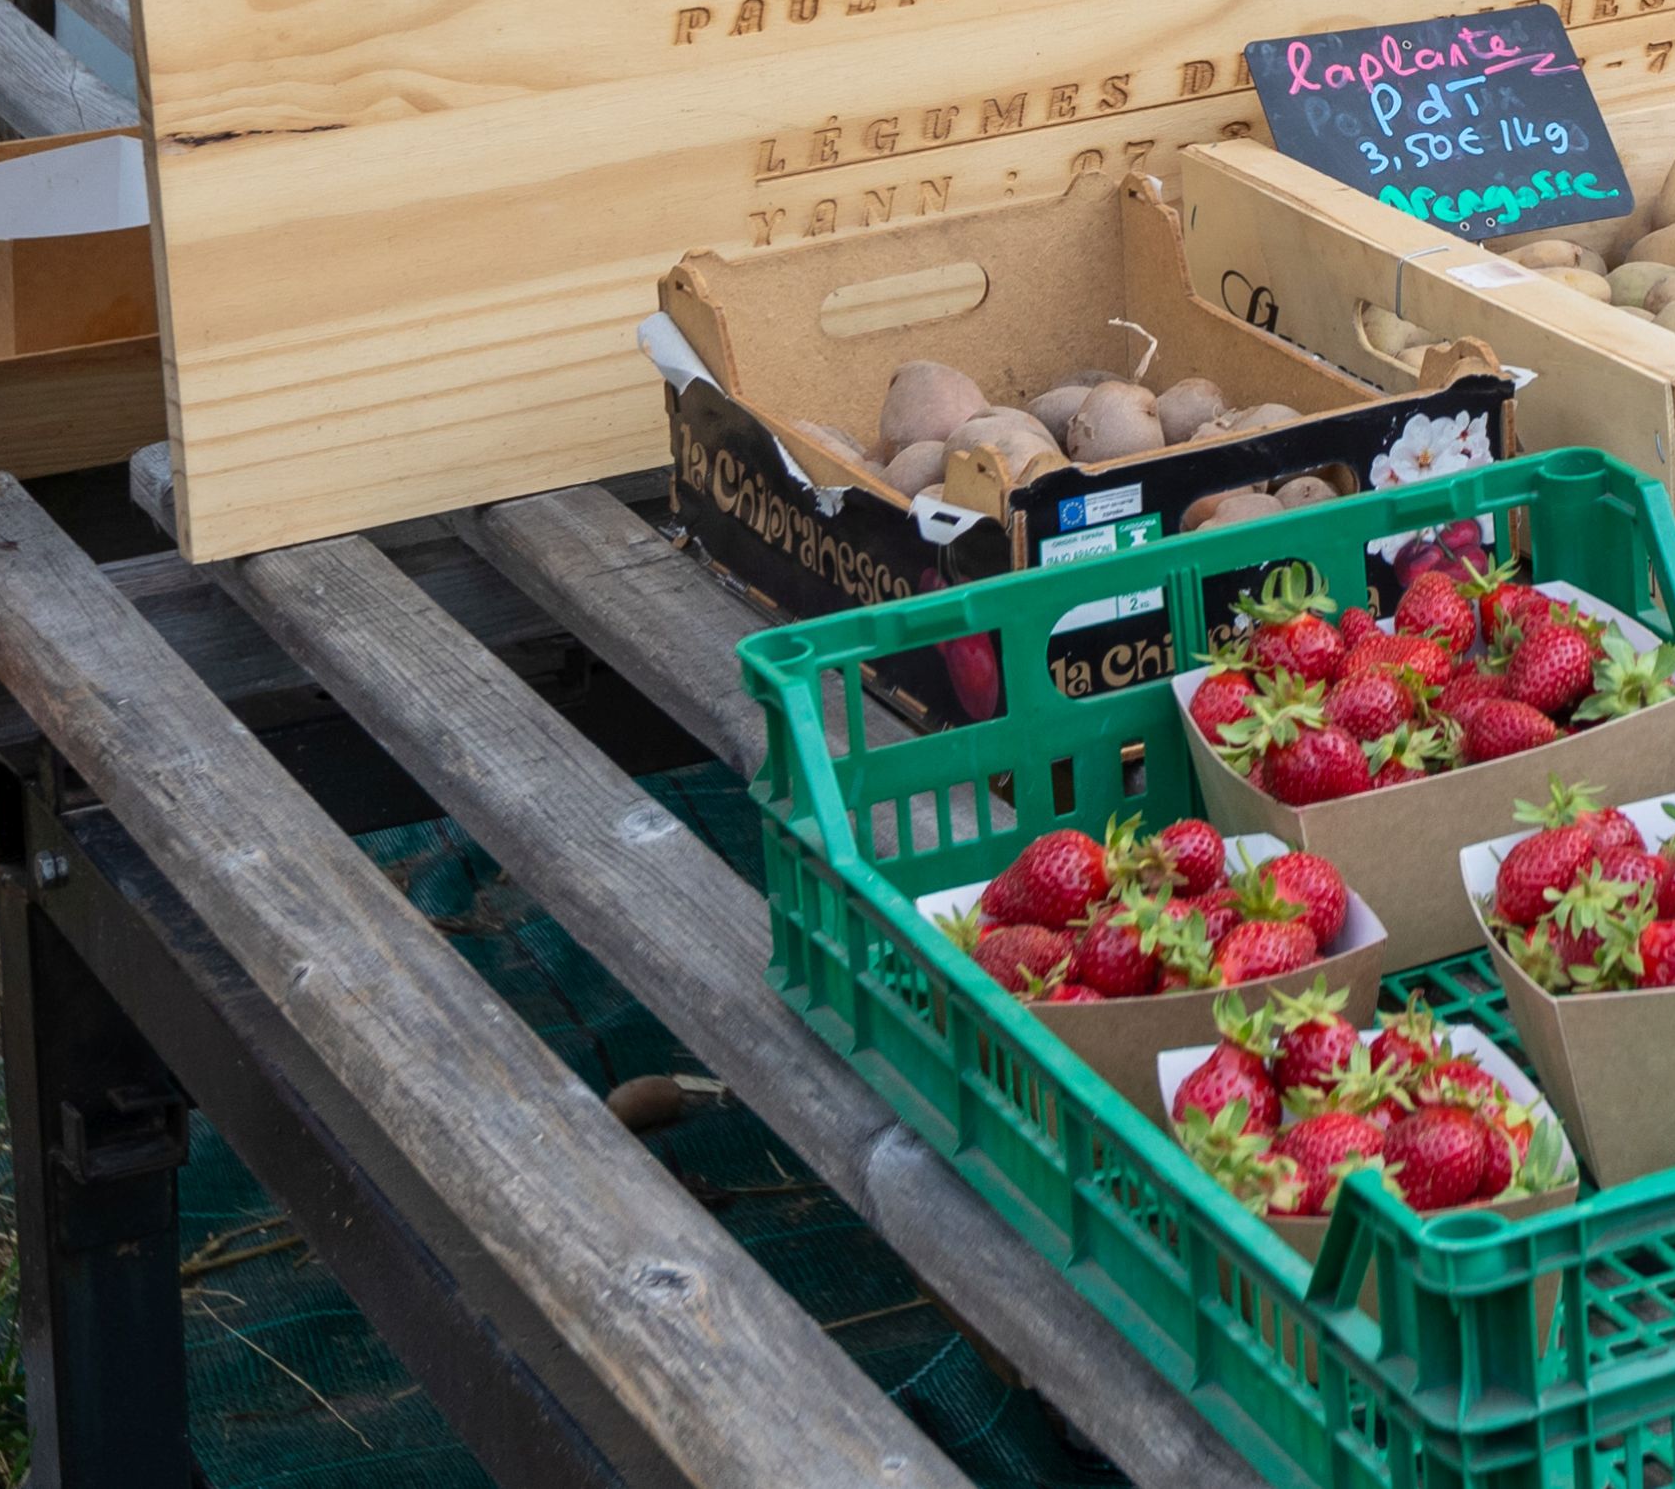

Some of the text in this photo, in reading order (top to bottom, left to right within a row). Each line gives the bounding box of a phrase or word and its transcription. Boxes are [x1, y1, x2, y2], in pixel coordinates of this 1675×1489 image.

[1287, 27, 1525, 96] laplante
[755, 71, 1132, 180] LÉGUMES
[748, 174, 954, 248] YANN
[679, 422, 709, 497] la
[1129, 597, 1140, 612] 2
[1049, 657, 1093, 699] la
